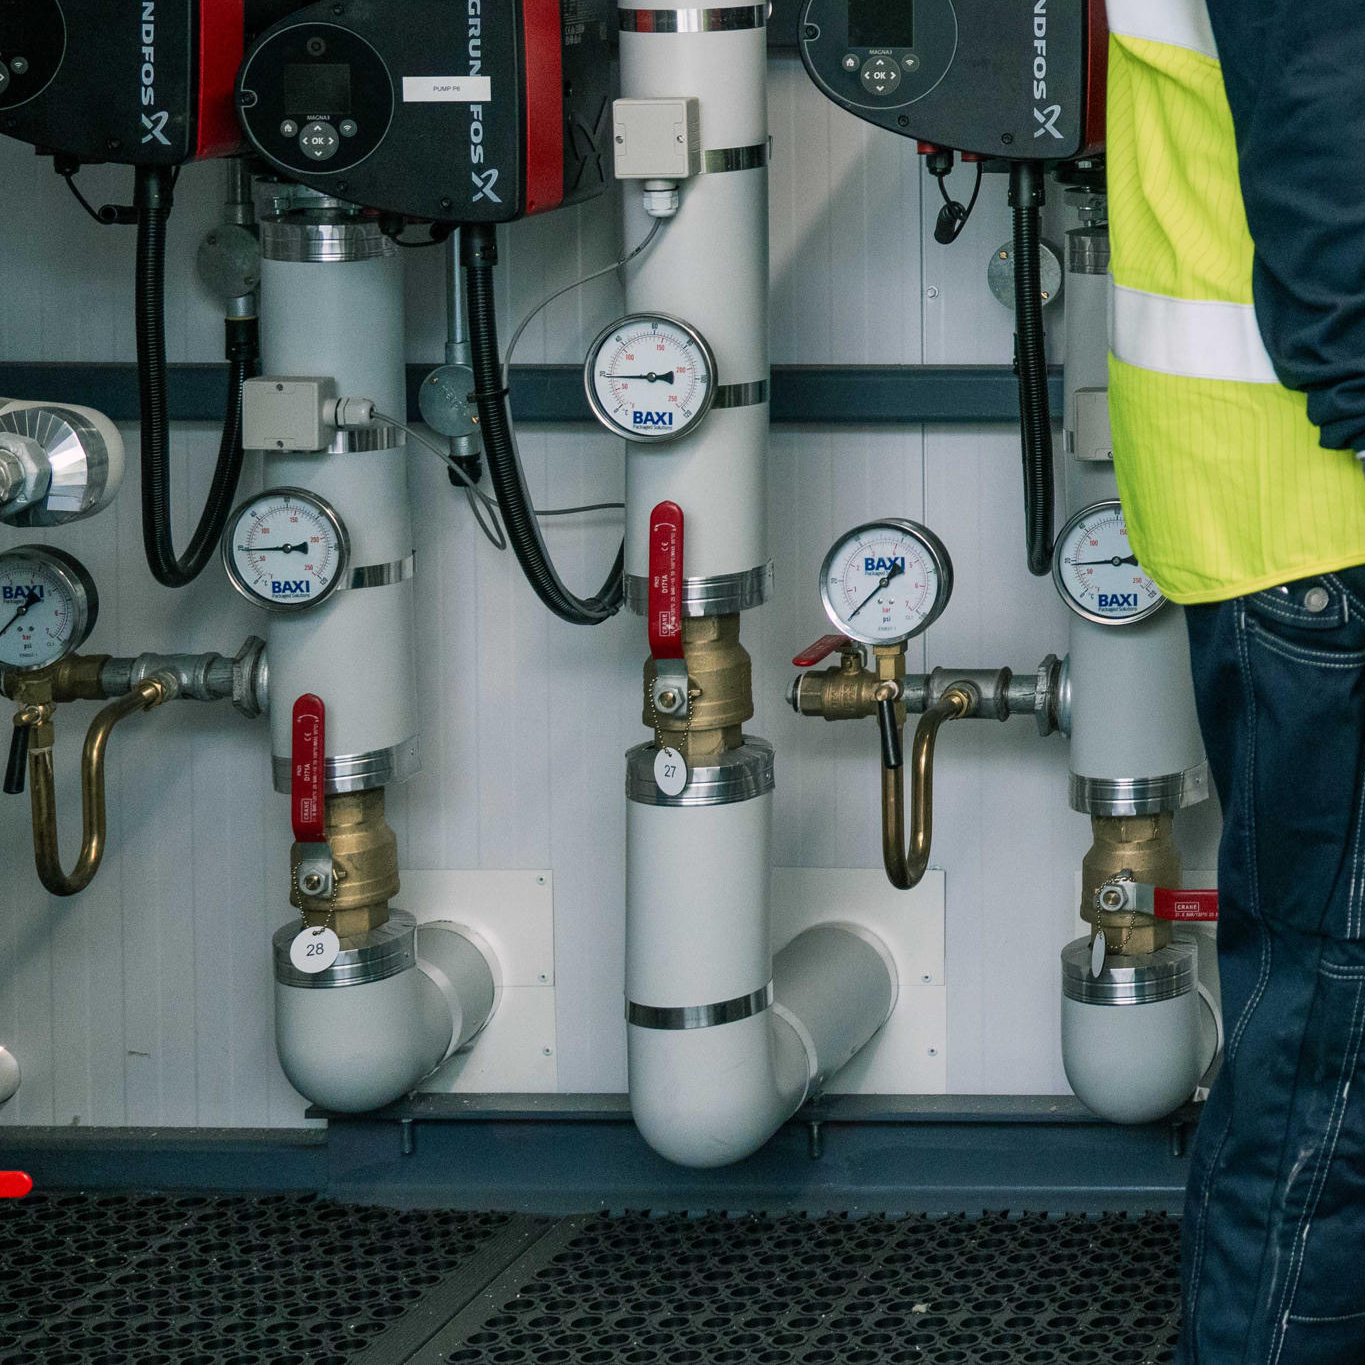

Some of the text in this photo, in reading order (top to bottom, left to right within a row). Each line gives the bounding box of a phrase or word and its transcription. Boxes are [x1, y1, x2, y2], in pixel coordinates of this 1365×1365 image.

[874, 72, 886, 80] OK
[311, 137, 324, 145] OK
[633, 411, 673, 425] BAXI
[864, 557, 905, 571] BAXI
[2, 584, 44, 600] BAXI
[271, 580, 310, 593] BAXI
[1098, 593, 1138, 607] BAXI
[664, 764, 677, 778] 27
[306, 942, 325, 957] 28
